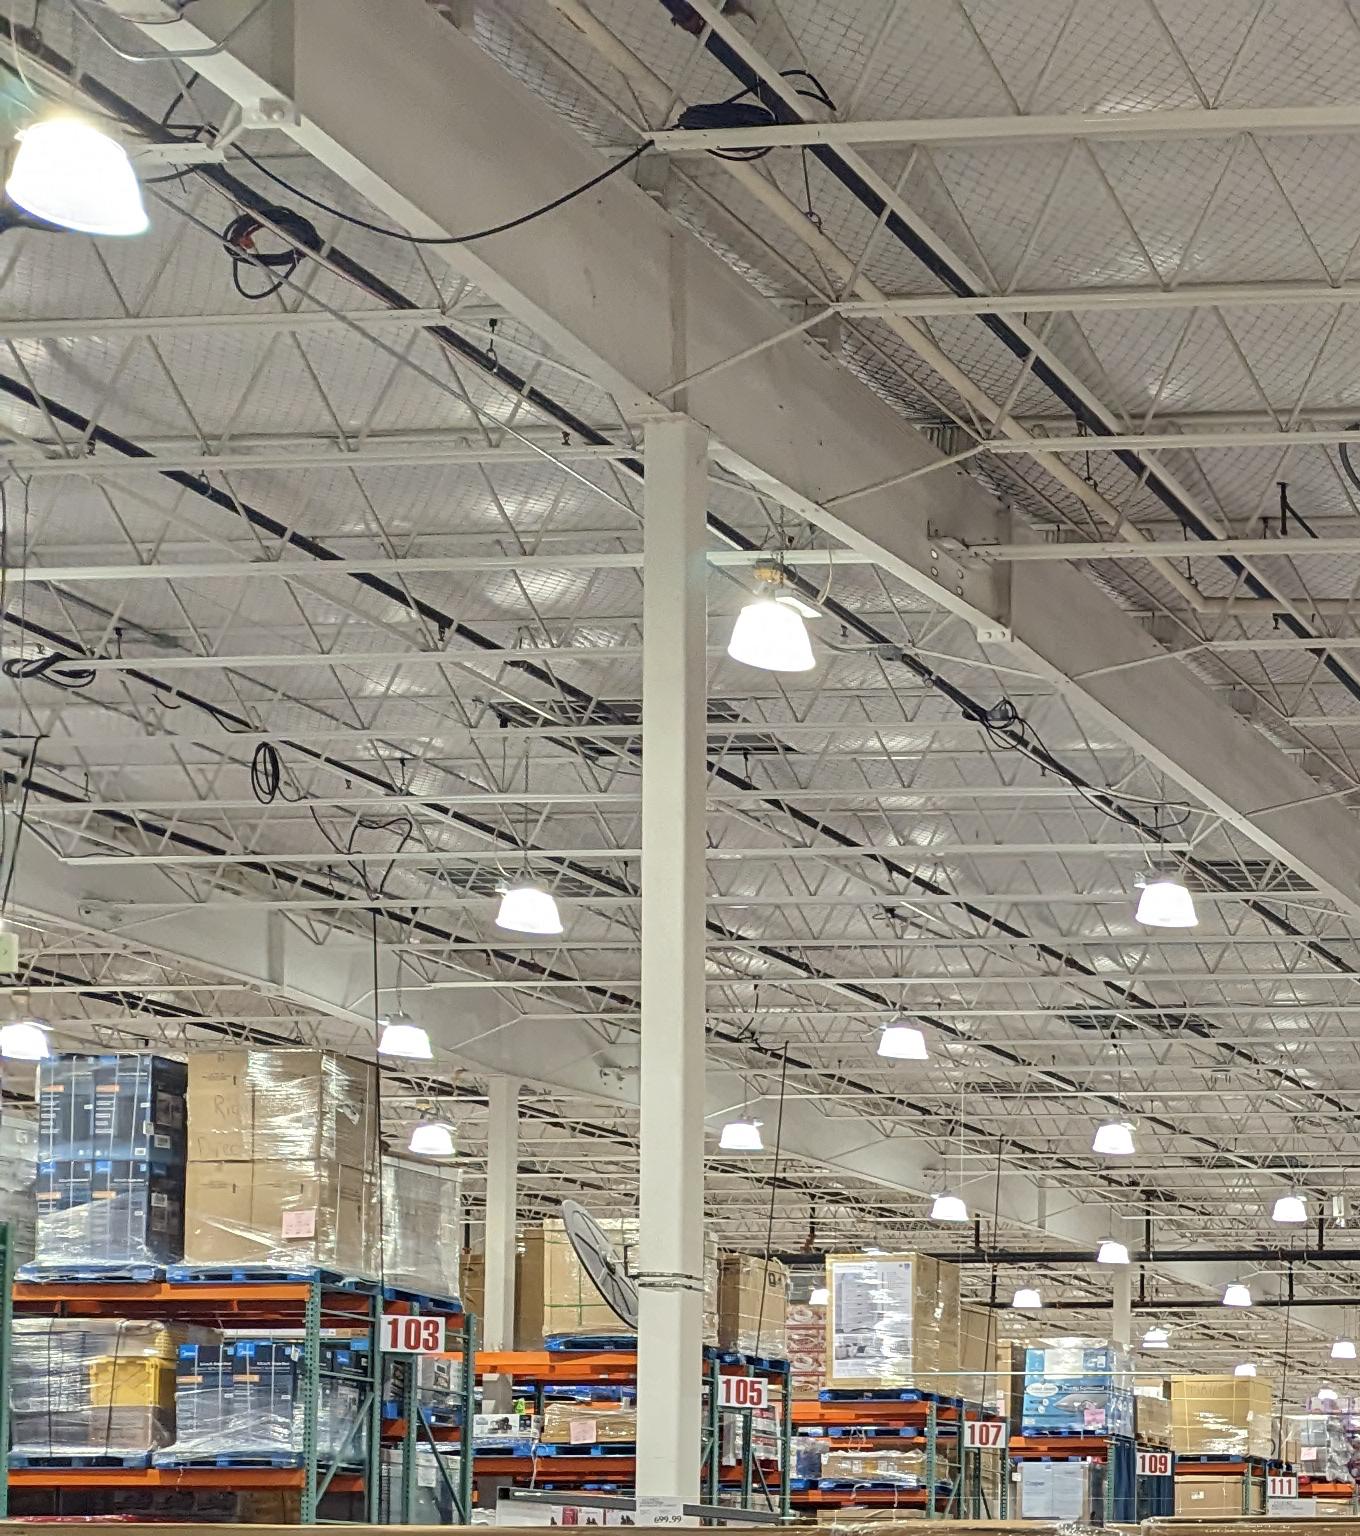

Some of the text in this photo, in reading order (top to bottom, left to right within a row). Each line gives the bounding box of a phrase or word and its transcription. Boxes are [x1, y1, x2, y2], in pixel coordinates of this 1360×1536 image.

[386, 1318, 440, 1352] 103
[722, 1378, 763, 1407] 105
[967, 1423, 1002, 1446] 107
[1139, 1454, 1168, 1474] 109
[1270, 1478, 1292, 1496] 111
